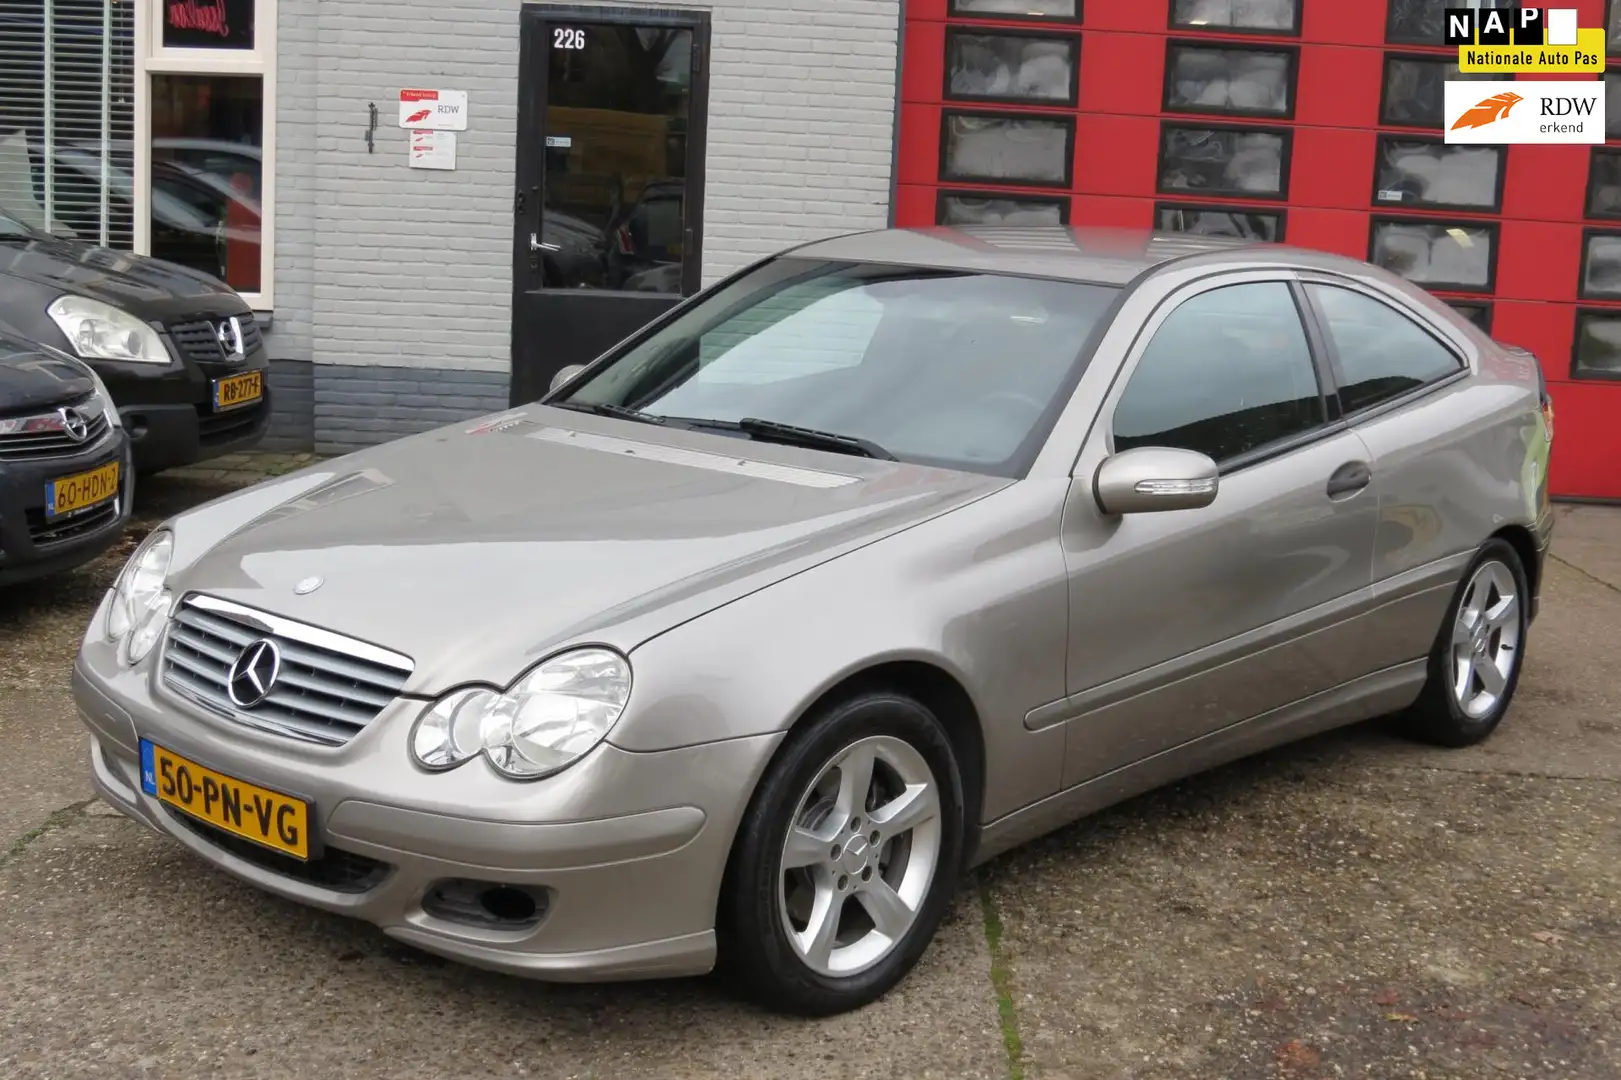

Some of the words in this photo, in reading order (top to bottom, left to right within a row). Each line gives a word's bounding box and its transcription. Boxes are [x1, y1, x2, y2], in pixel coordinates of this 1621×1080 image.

[553, 28, 585, 50] 226
[437, 104, 460, 114] RDW
[145, 770, 156, 786] NL
[160, 756, 298, 846] 50-PN-VG
